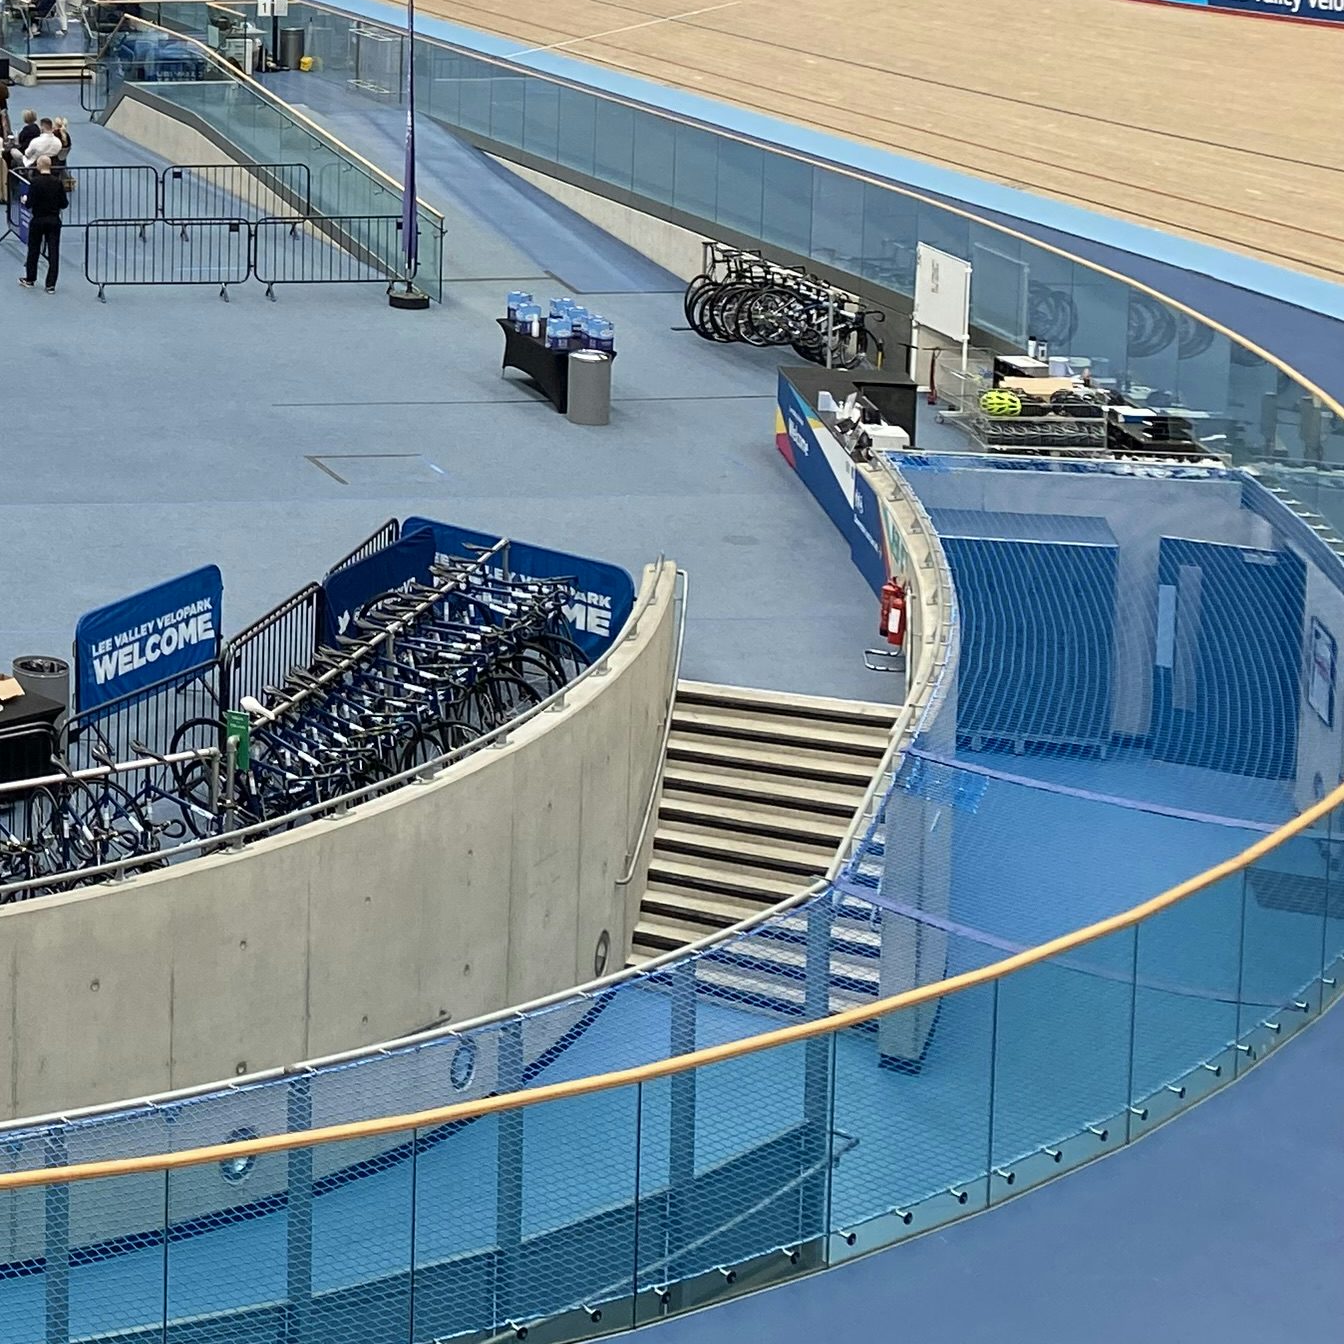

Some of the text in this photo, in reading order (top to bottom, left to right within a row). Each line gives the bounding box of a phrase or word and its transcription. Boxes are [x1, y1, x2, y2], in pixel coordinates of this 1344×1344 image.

[92, 597, 213, 657] LEE VALLEY VELOPARK
[93, 612, 215, 685] WELCOME
